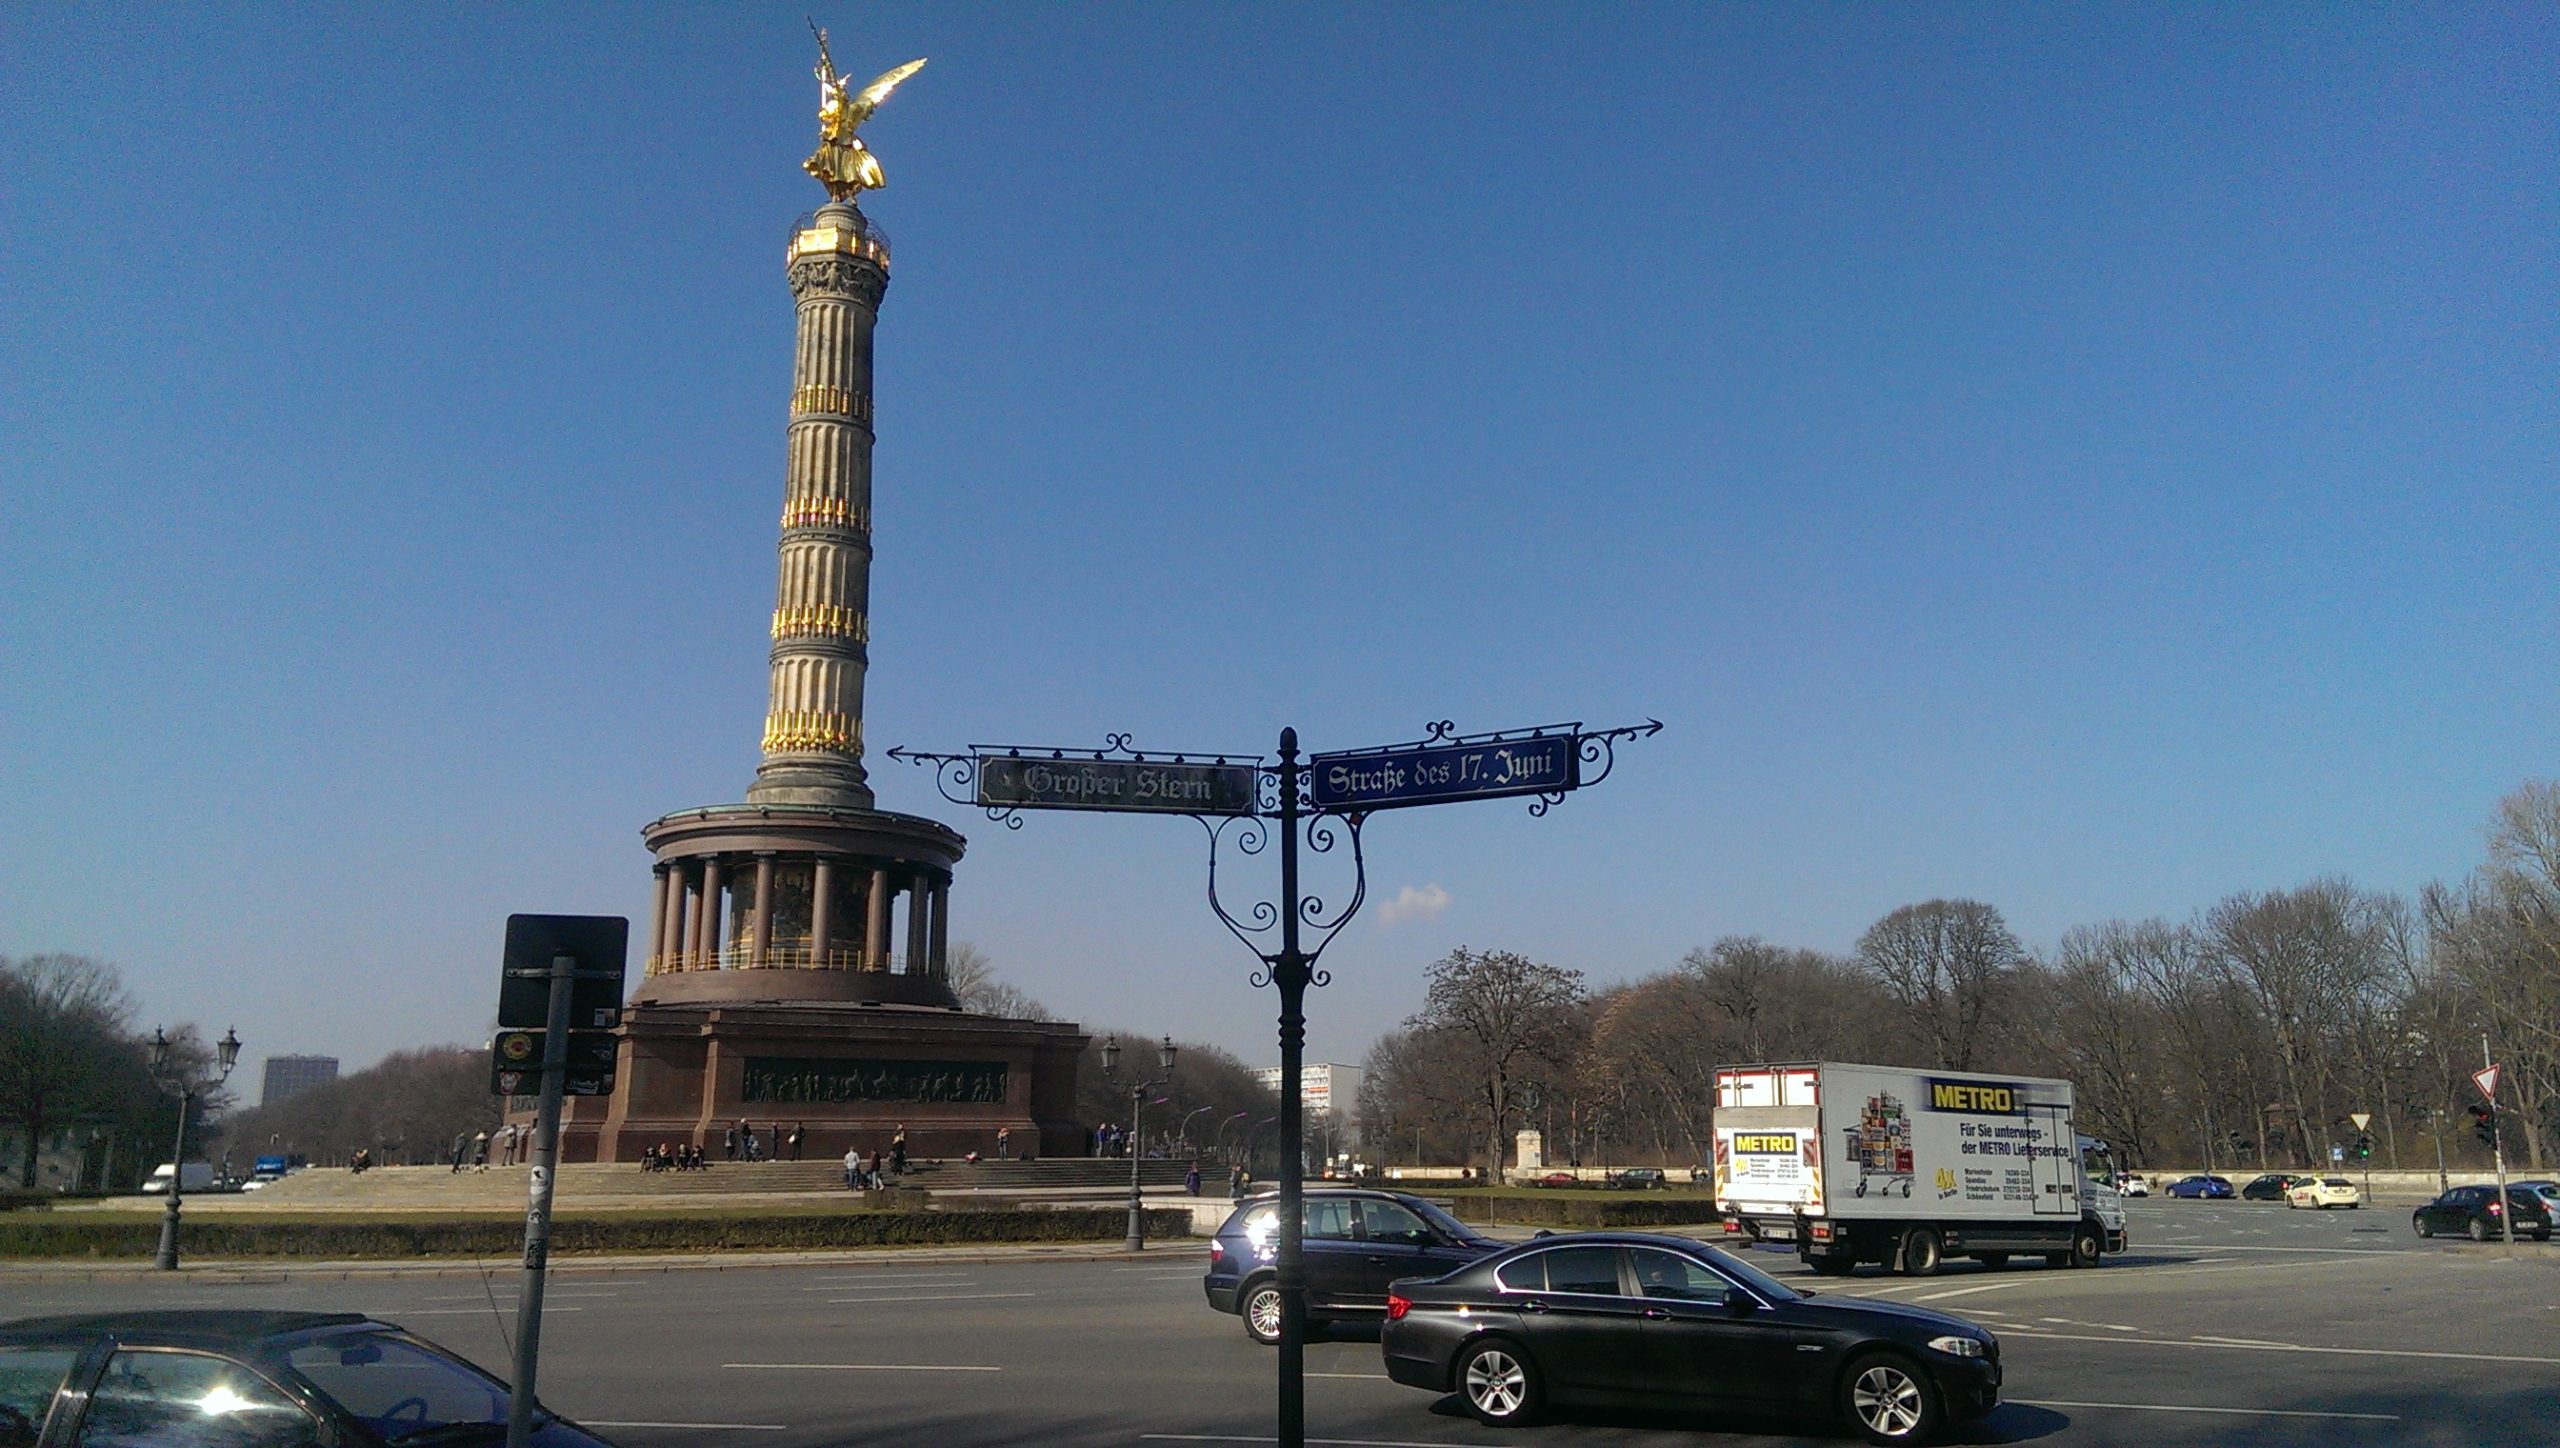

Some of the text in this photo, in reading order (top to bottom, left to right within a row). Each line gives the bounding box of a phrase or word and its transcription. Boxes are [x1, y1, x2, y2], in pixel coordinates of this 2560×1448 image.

[1024, 764, 1213, 800] Großer Stern
[1328, 747, 1553, 794] Straße des 17. Juni
[1933, 1084, 2012, 1112] METRO
[1735, 1135, 1795, 1152] METRO
[1960, 1122, 1976, 1137] Für
[1977, 1123, 1992, 1137] Sie
[1994, 1124, 2042, 1142] unterwegs
[1961, 1140, 2070, 1158] der METRO Lieferservice
